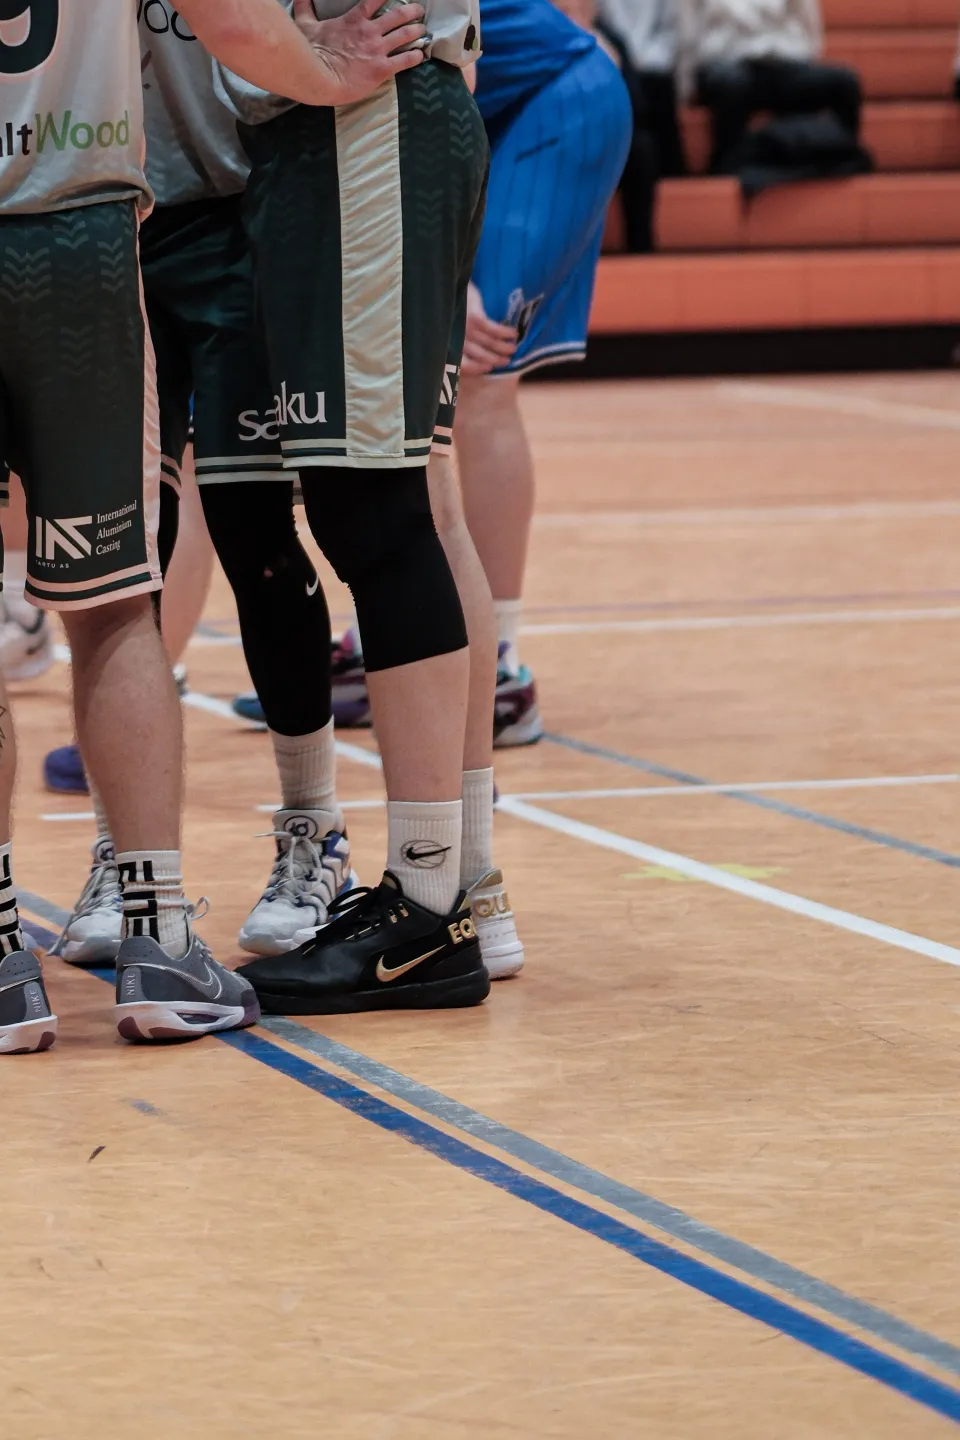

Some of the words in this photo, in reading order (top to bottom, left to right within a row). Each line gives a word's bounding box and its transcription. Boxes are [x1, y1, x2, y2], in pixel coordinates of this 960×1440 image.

[97, 500, 137, 524] International
[96, 520, 132, 539] Aluminium
[95, 539, 121, 555] Casting
[126, 971, 137, 997] NIKE
[30, 989, 42, 1013] NIKE
